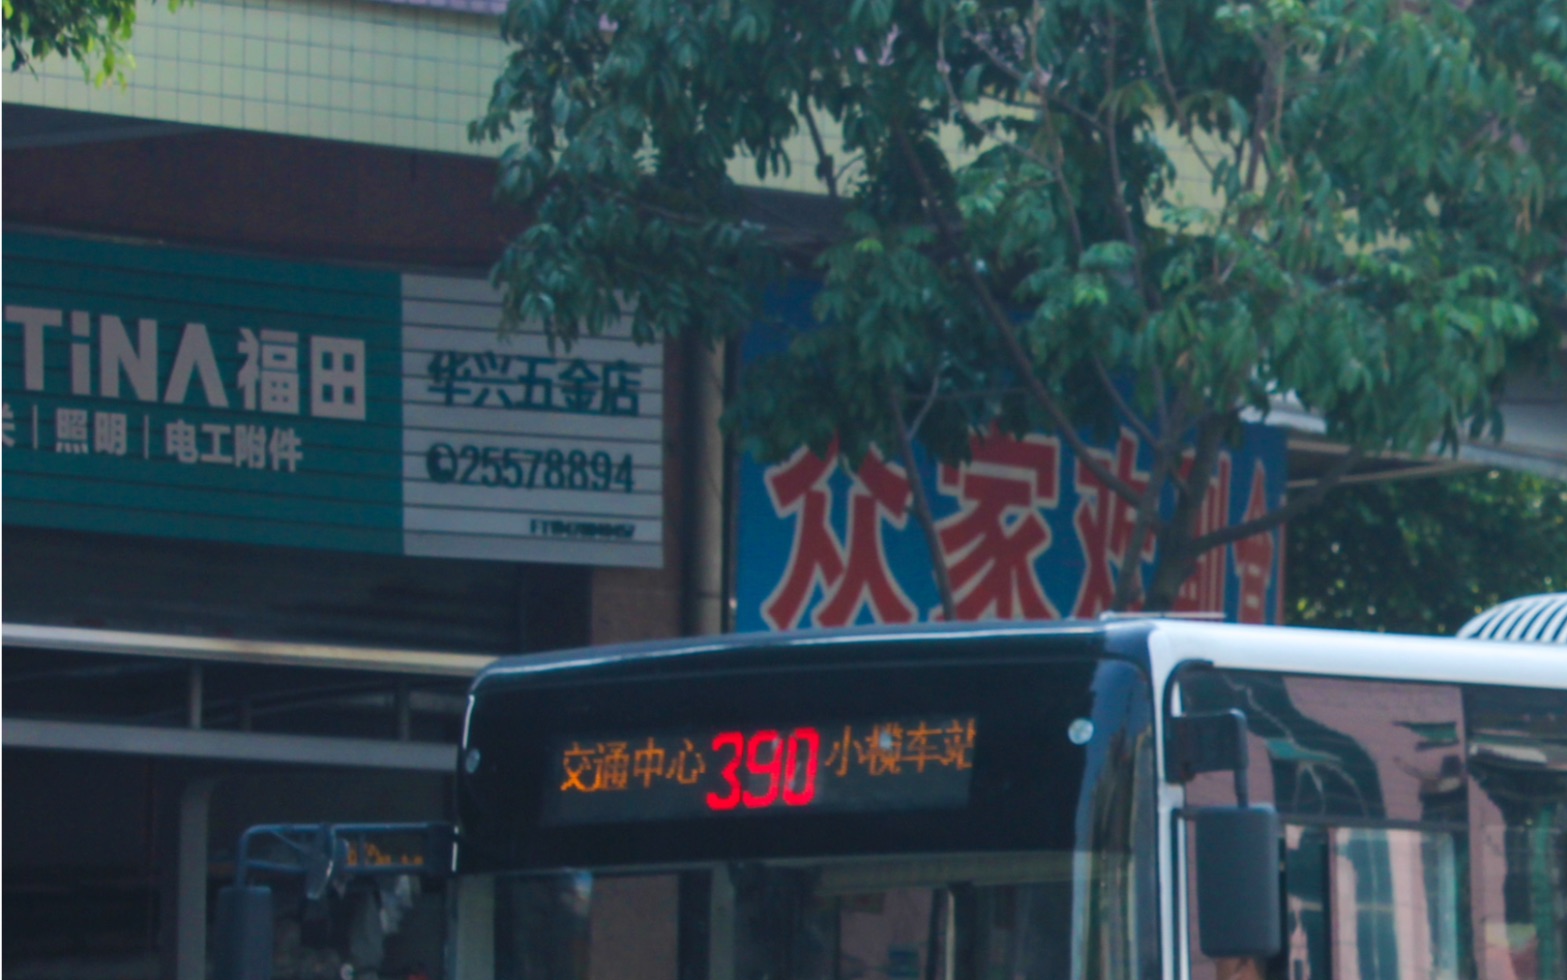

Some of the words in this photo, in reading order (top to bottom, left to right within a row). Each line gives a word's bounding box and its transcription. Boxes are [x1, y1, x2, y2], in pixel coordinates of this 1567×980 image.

[236, 327, 366, 420] 福田
[428, 350, 643, 417] 华兴五金店
[56, 408, 127, 455] 照明
[165, 420, 303, 471] 电工附件
[459, 445, 634, 493] 25578894
[560, 737, 706, 792] 交通中心
[706, 727, 820, 811] 390
